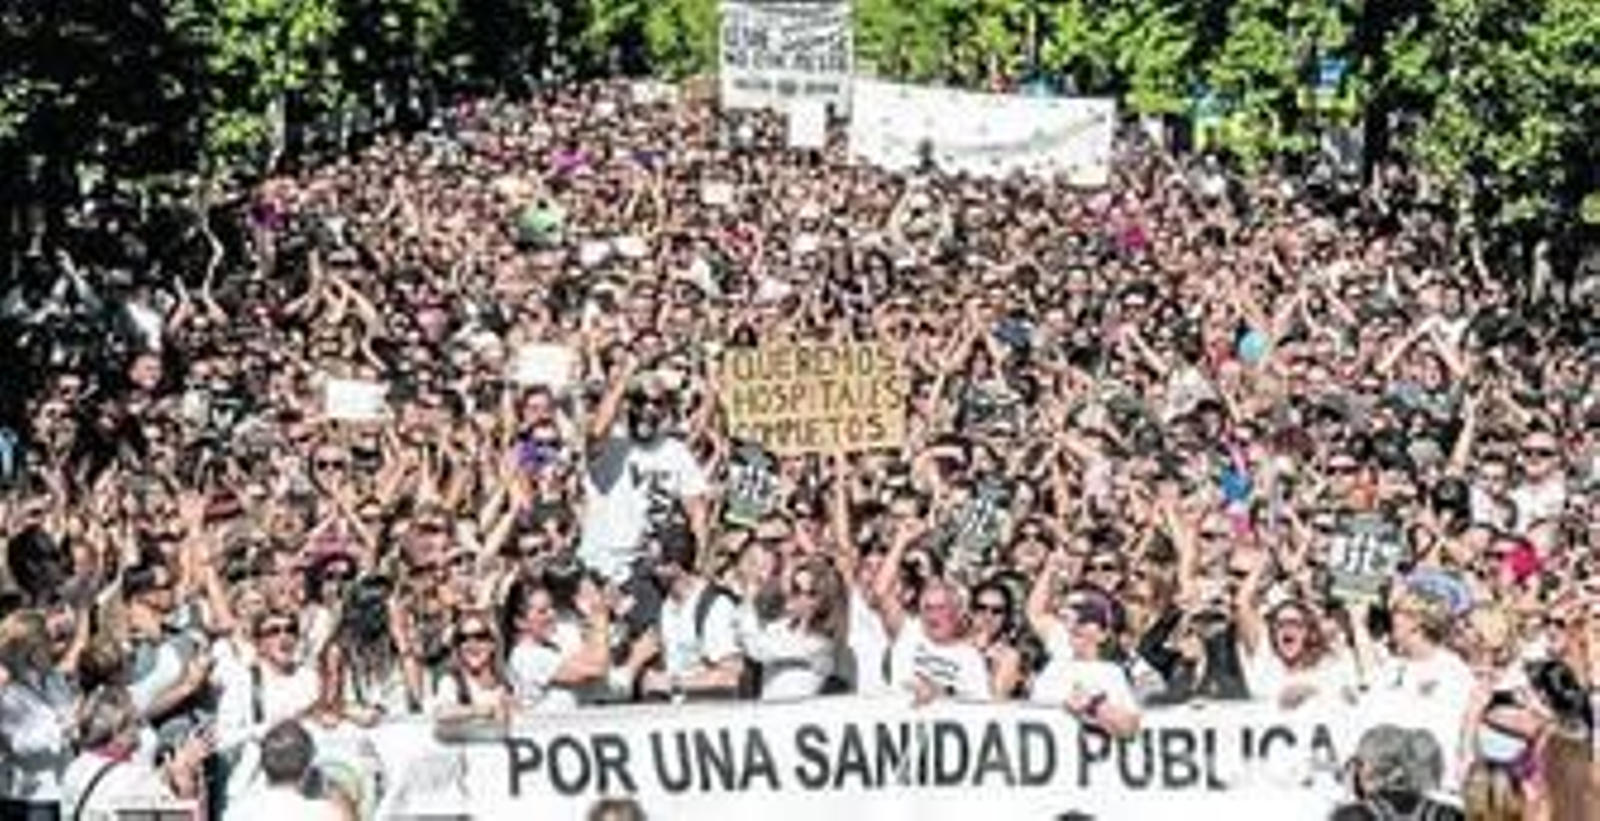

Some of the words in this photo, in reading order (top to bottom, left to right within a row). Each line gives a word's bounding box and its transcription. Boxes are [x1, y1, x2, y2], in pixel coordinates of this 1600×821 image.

[732, 347, 897, 381] QUEREMOS
[732, 376, 902, 416] HOSPITALES
[505, 734, 637, 798] POR
[649, 727, 781, 793] UNA
[795, 722, 1058, 790] SANIDAD
